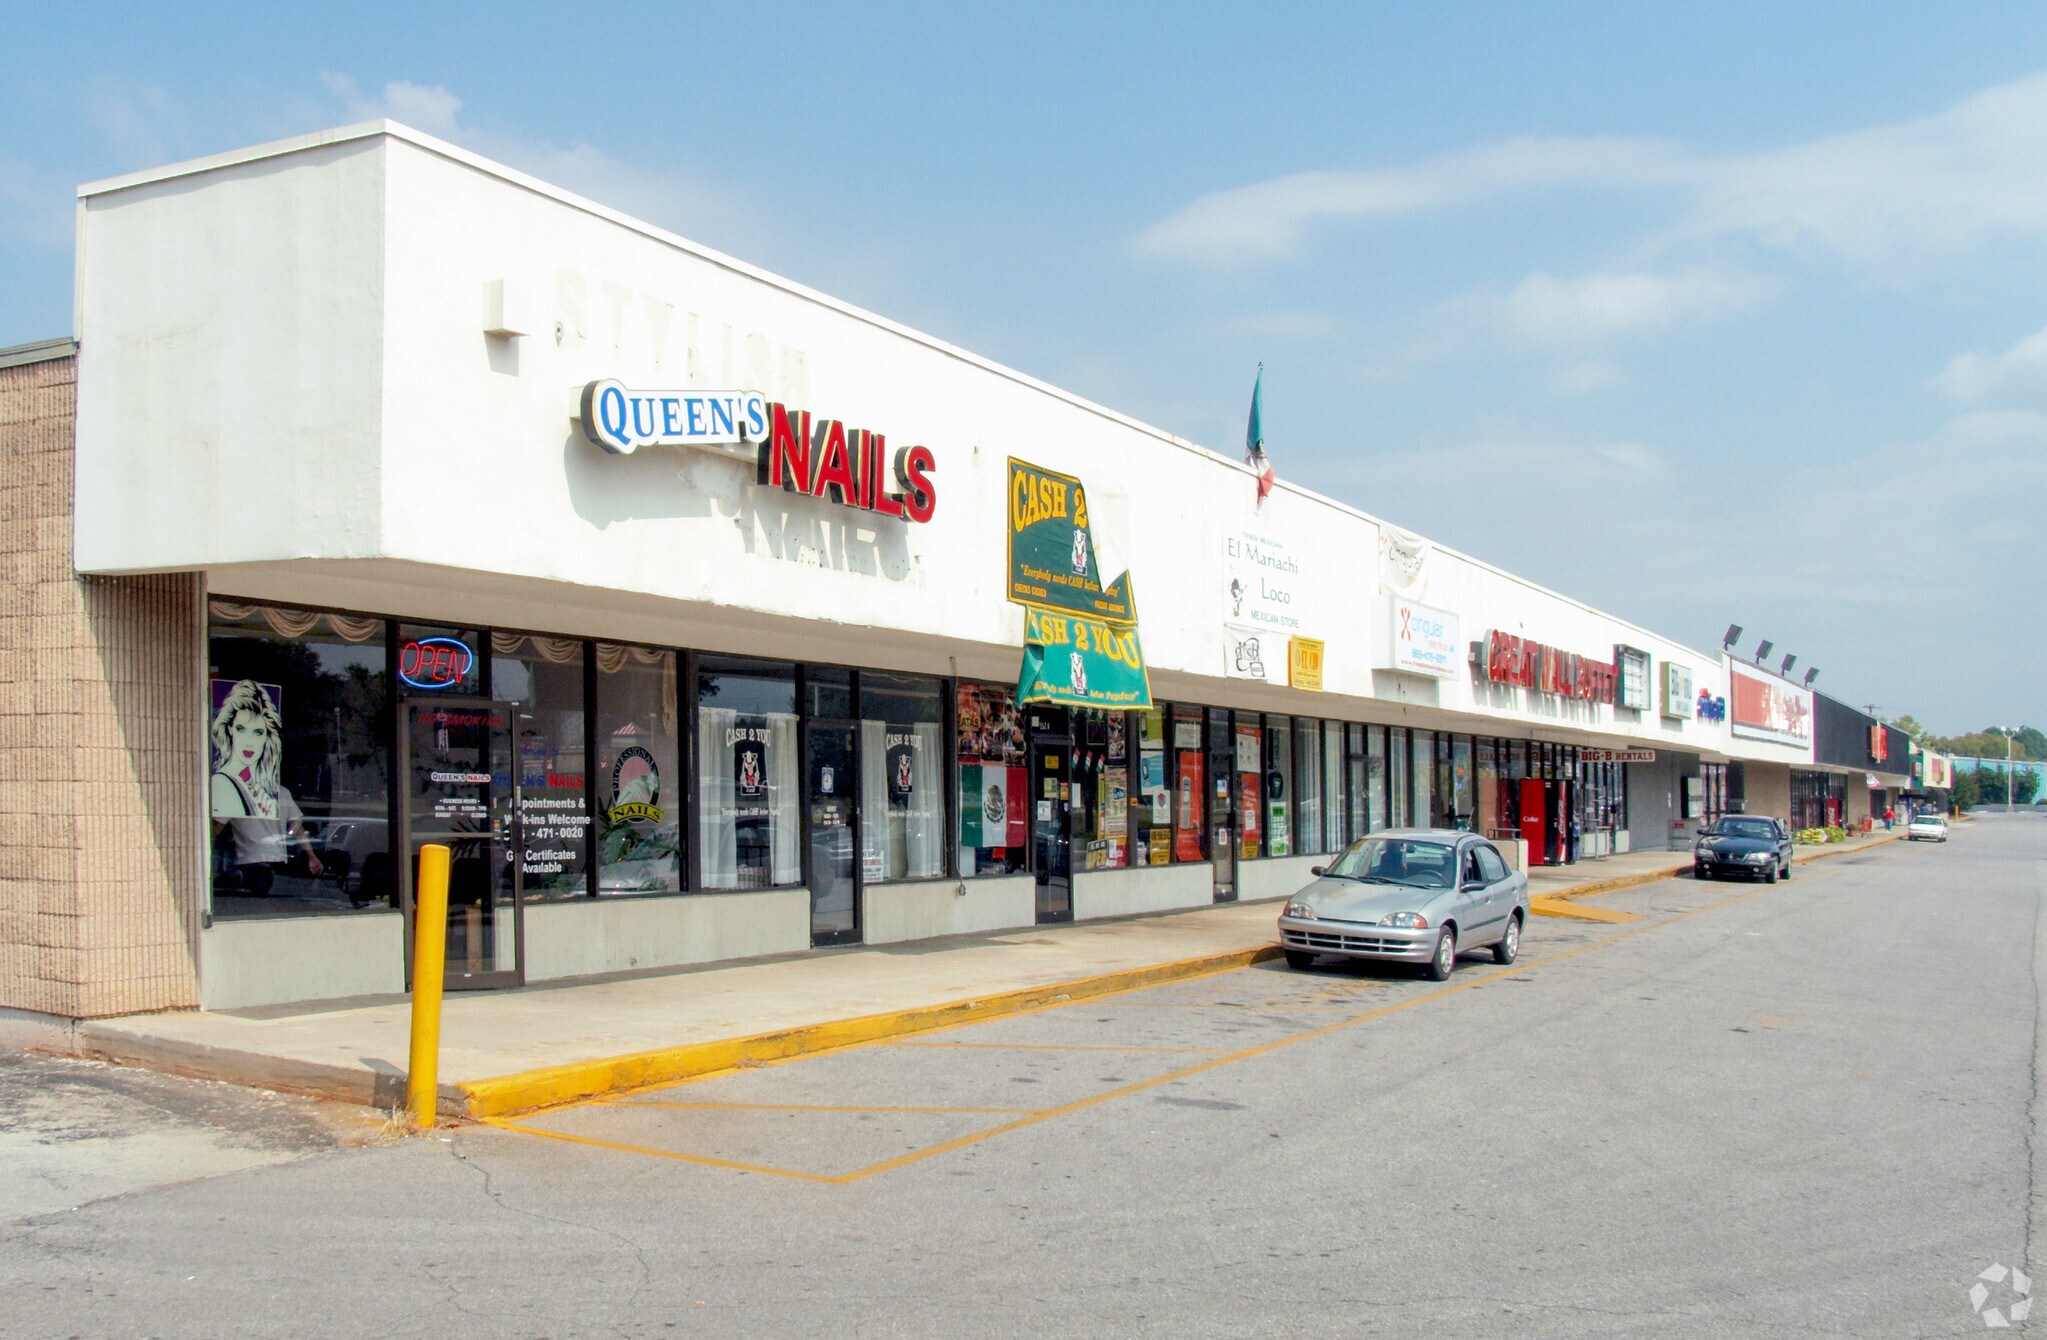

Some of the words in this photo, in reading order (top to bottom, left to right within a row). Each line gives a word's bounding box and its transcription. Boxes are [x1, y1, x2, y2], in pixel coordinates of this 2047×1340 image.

[600, 387, 764, 446] QUEEN'S
[767, 402, 936, 523] NAILS
[1013, 469, 1067, 532] CASH
[1074, 486, 1088, 530] 2
[1228, 537, 1240, 559] El
[1245, 543, 1299, 575] Mariachi
[1261, 577, 1291, 604] Loco
[1251, 609, 1279, 625] MEXICAN
[1280, 616, 1300, 629] STORE
[1074, 622, 1089, 651] 2
[1091, 626, 1140, 669] YOU
[399, 641, 467, 685] OPEN
[1487, 629, 1538, 688] GREAT
[726, 729, 747, 747] CASH
[749, 729, 755, 741] 2
[756, 729, 771, 748] YOU
[886, 733, 902, 750] CASH
[904, 734, 910, 745] 2
[1581, 751, 1612, 761] BIG-B
[1615, 752, 1653, 761] RENTALS
[432, 772, 466, 782] QUEEN'S
[467, 774, 490, 782] NAILS
[613, 747, 657, 790] PROFESSIONAL
[578, 797, 586, 809] &
[614, 805, 660, 820] NAILS
[504, 814, 546, 825] Wk-ins
[548, 813, 591, 825] Welcome
[1523, 815, 1540, 823] Coke
[525, 850, 577, 861] Certificates
[522, 861, 562, 873] Available
